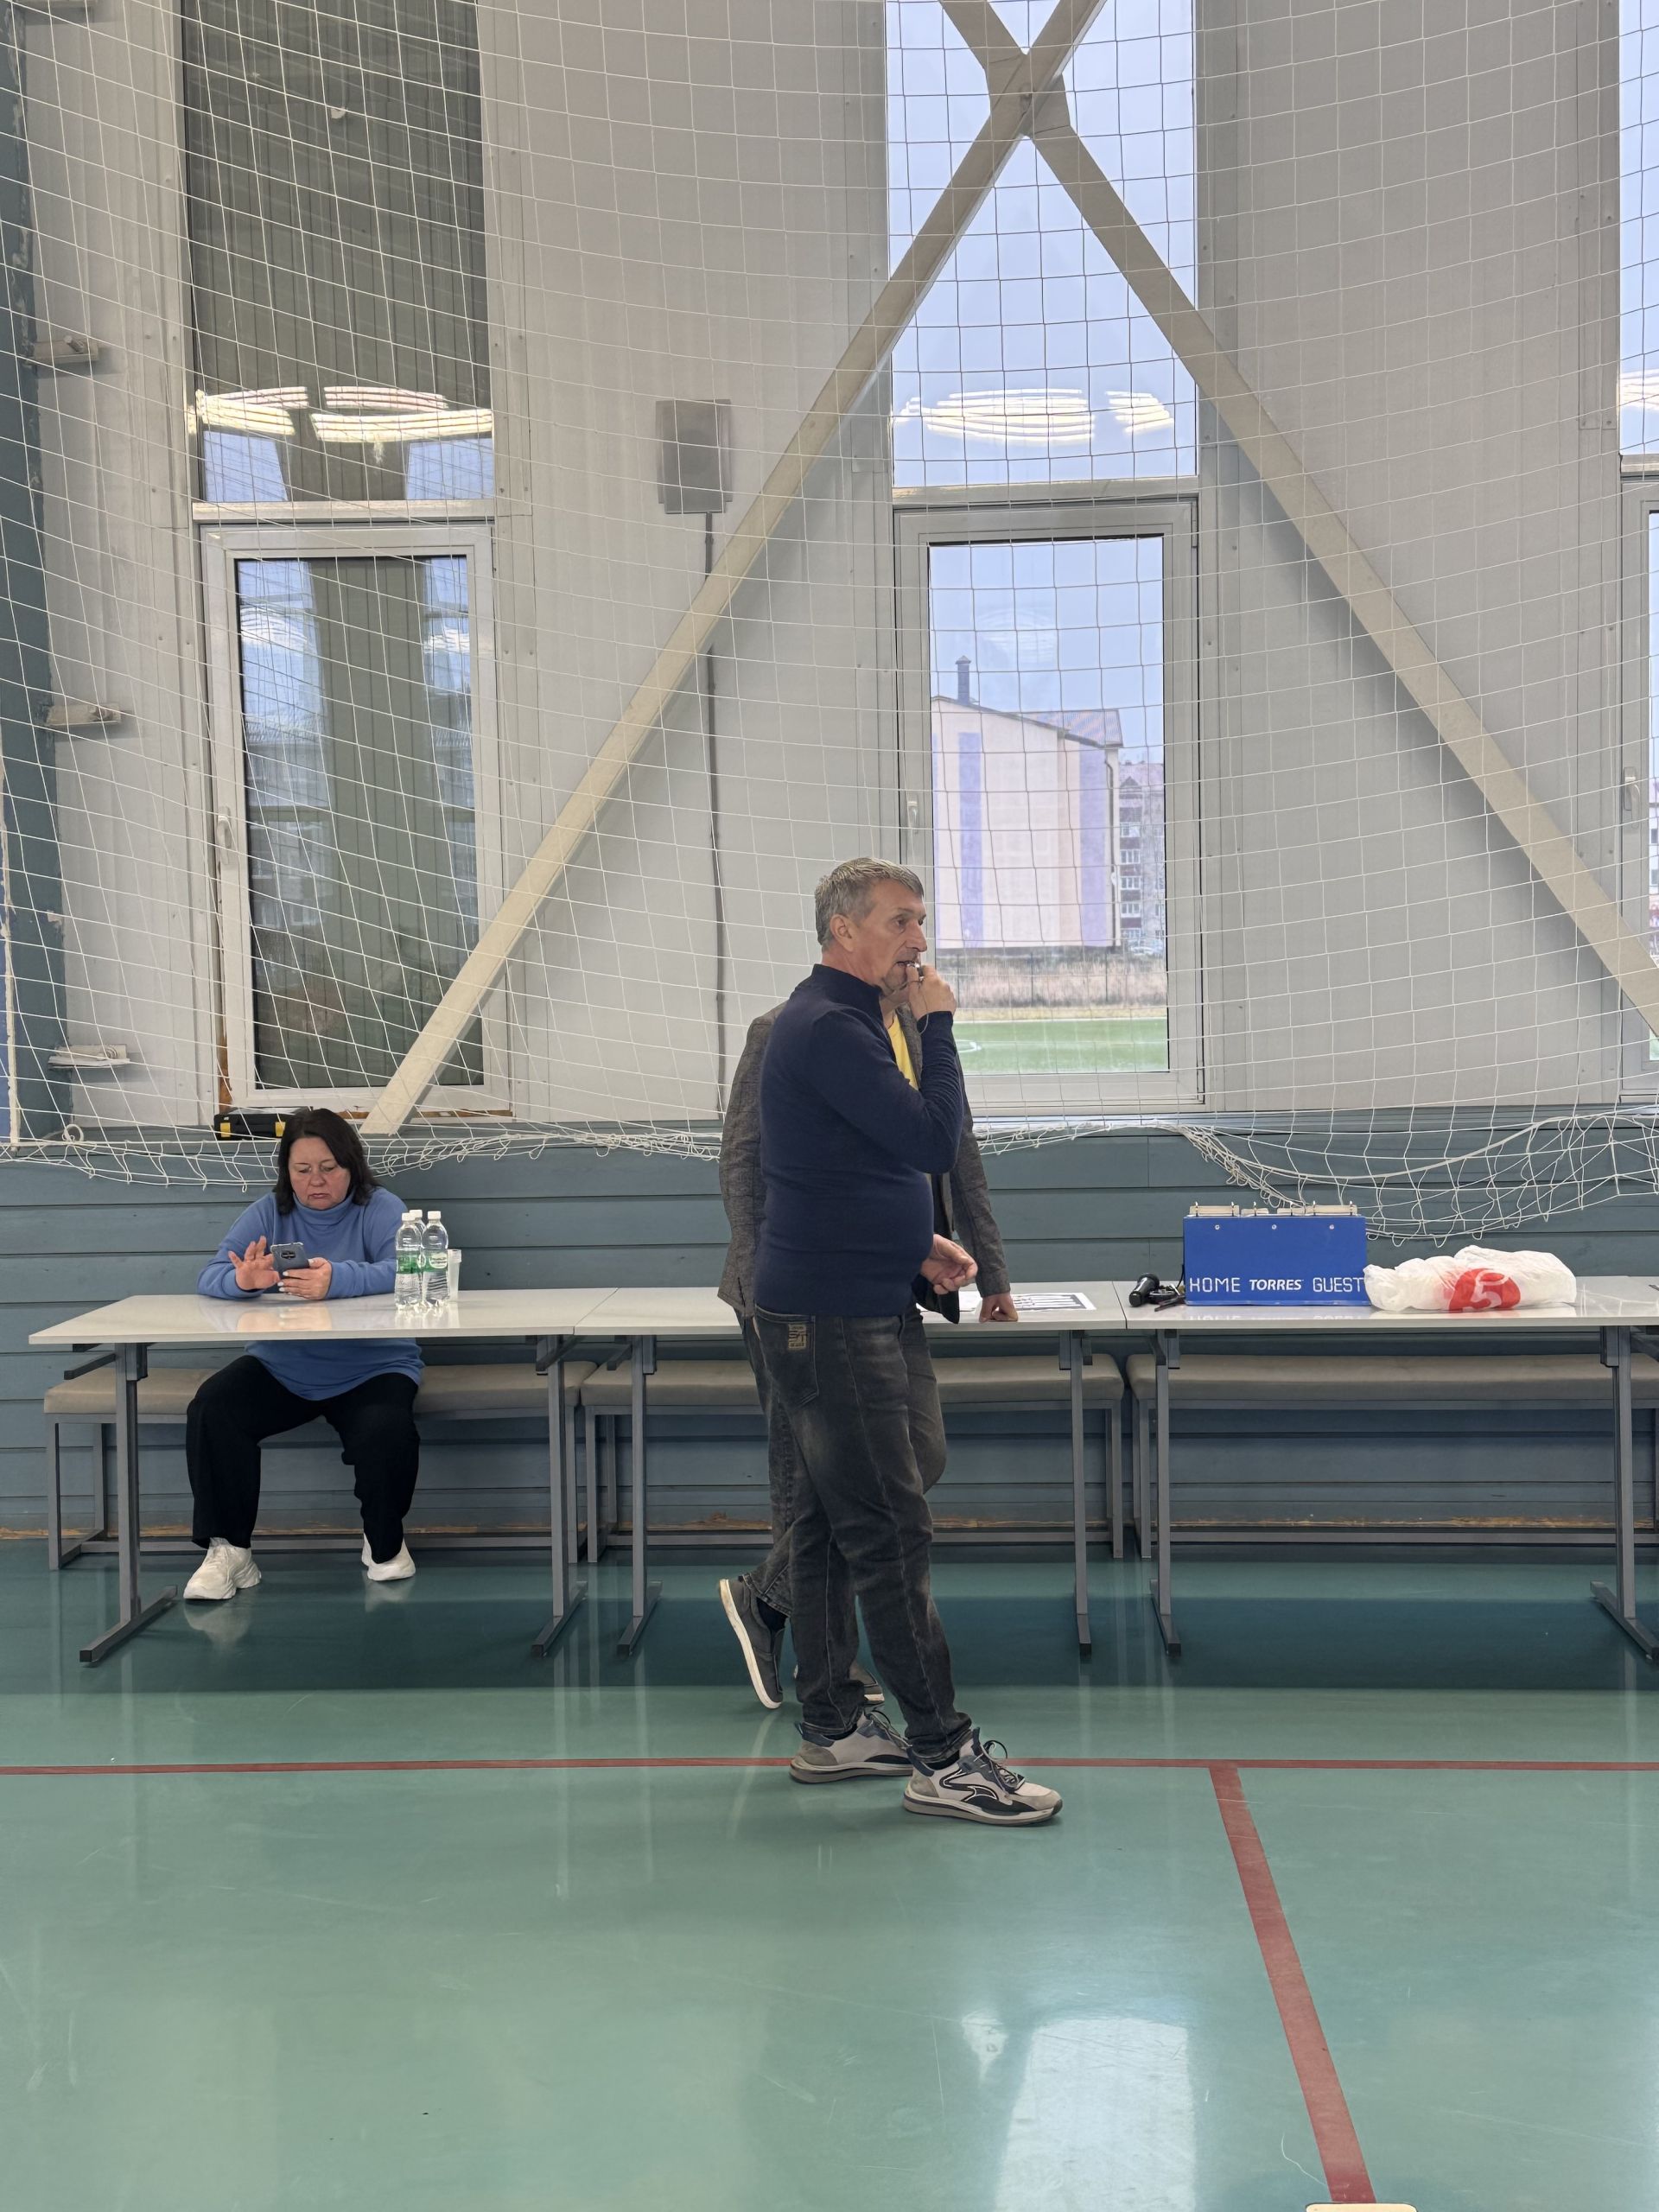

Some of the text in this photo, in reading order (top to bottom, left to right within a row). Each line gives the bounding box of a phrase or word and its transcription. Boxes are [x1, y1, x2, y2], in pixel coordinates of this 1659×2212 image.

[1189, 1277, 1365, 1293] HOME TORRES GUEST
